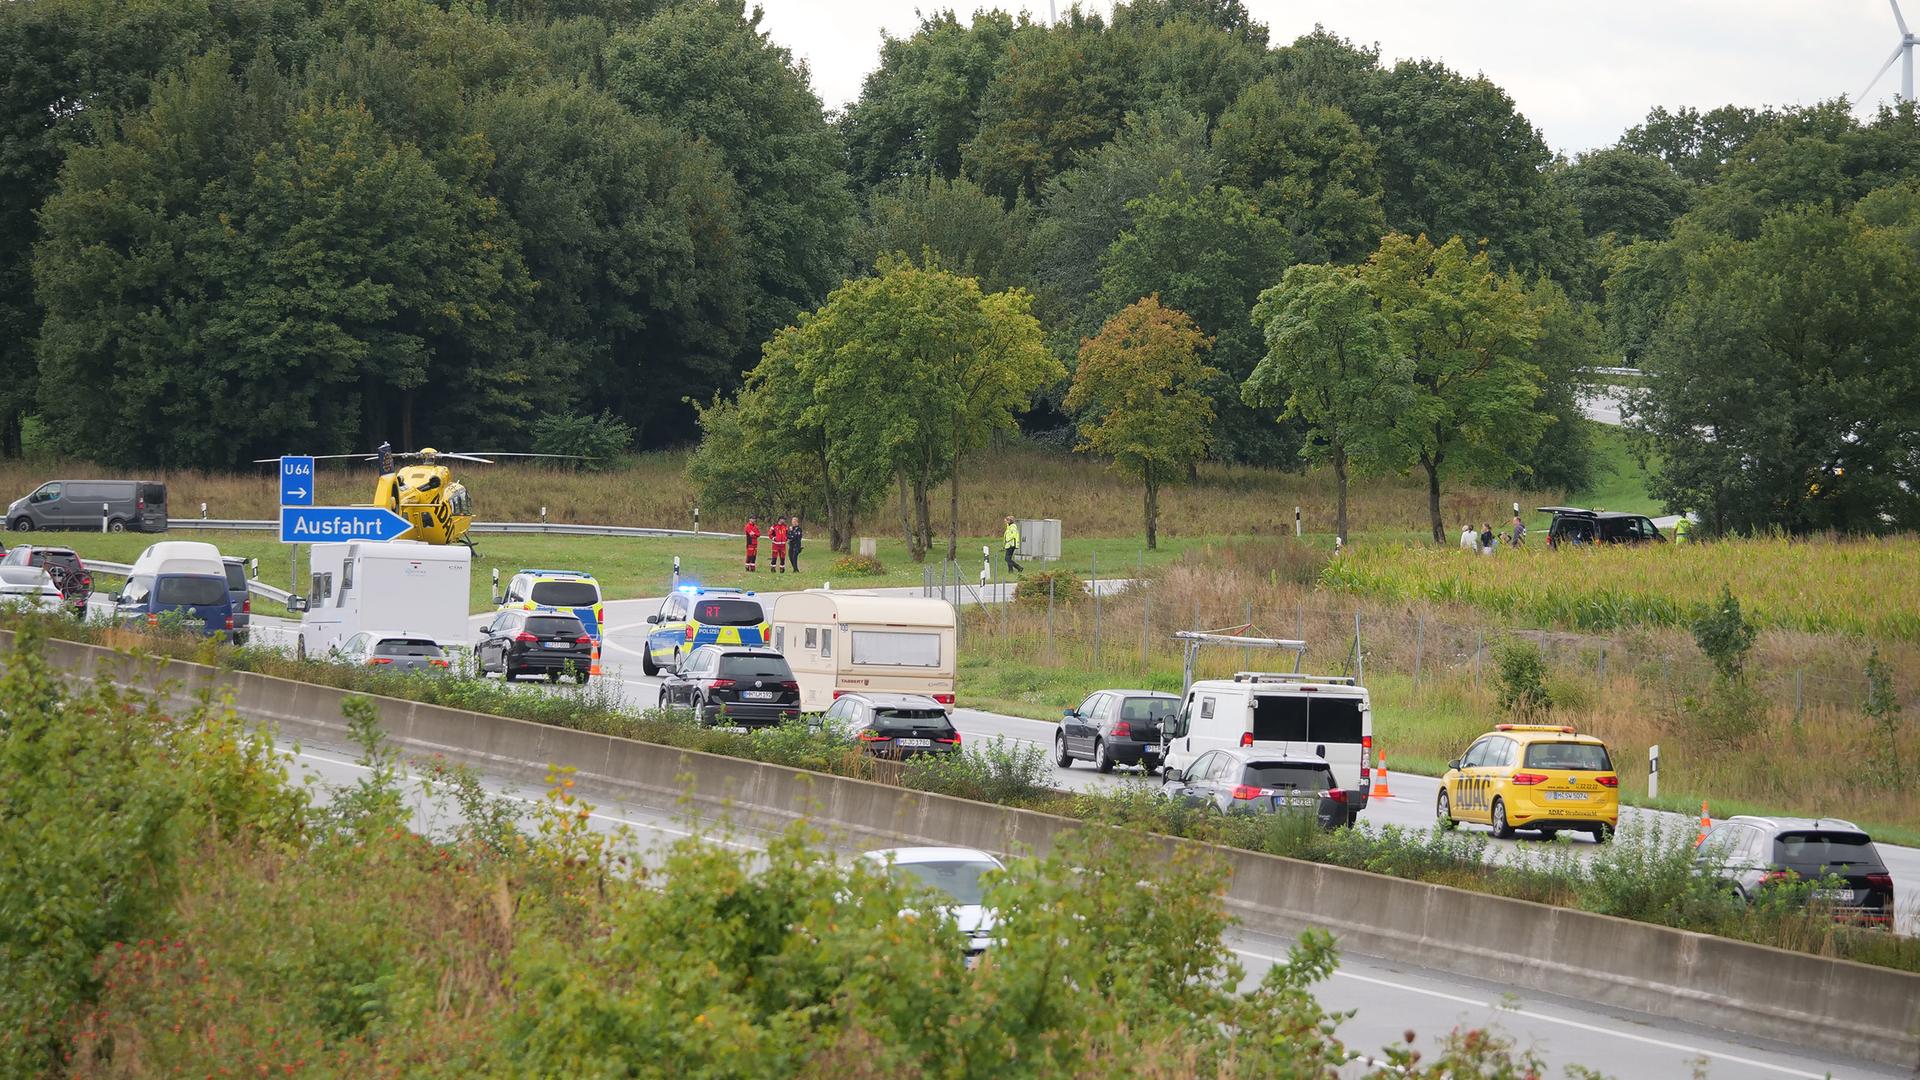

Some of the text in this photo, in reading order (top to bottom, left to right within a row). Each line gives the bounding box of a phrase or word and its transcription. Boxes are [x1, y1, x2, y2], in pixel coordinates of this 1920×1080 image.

[293, 516, 382, 535] Ausfahrt
[705, 606, 720, 618] RT
[1456, 775, 1490, 811] ADAC
